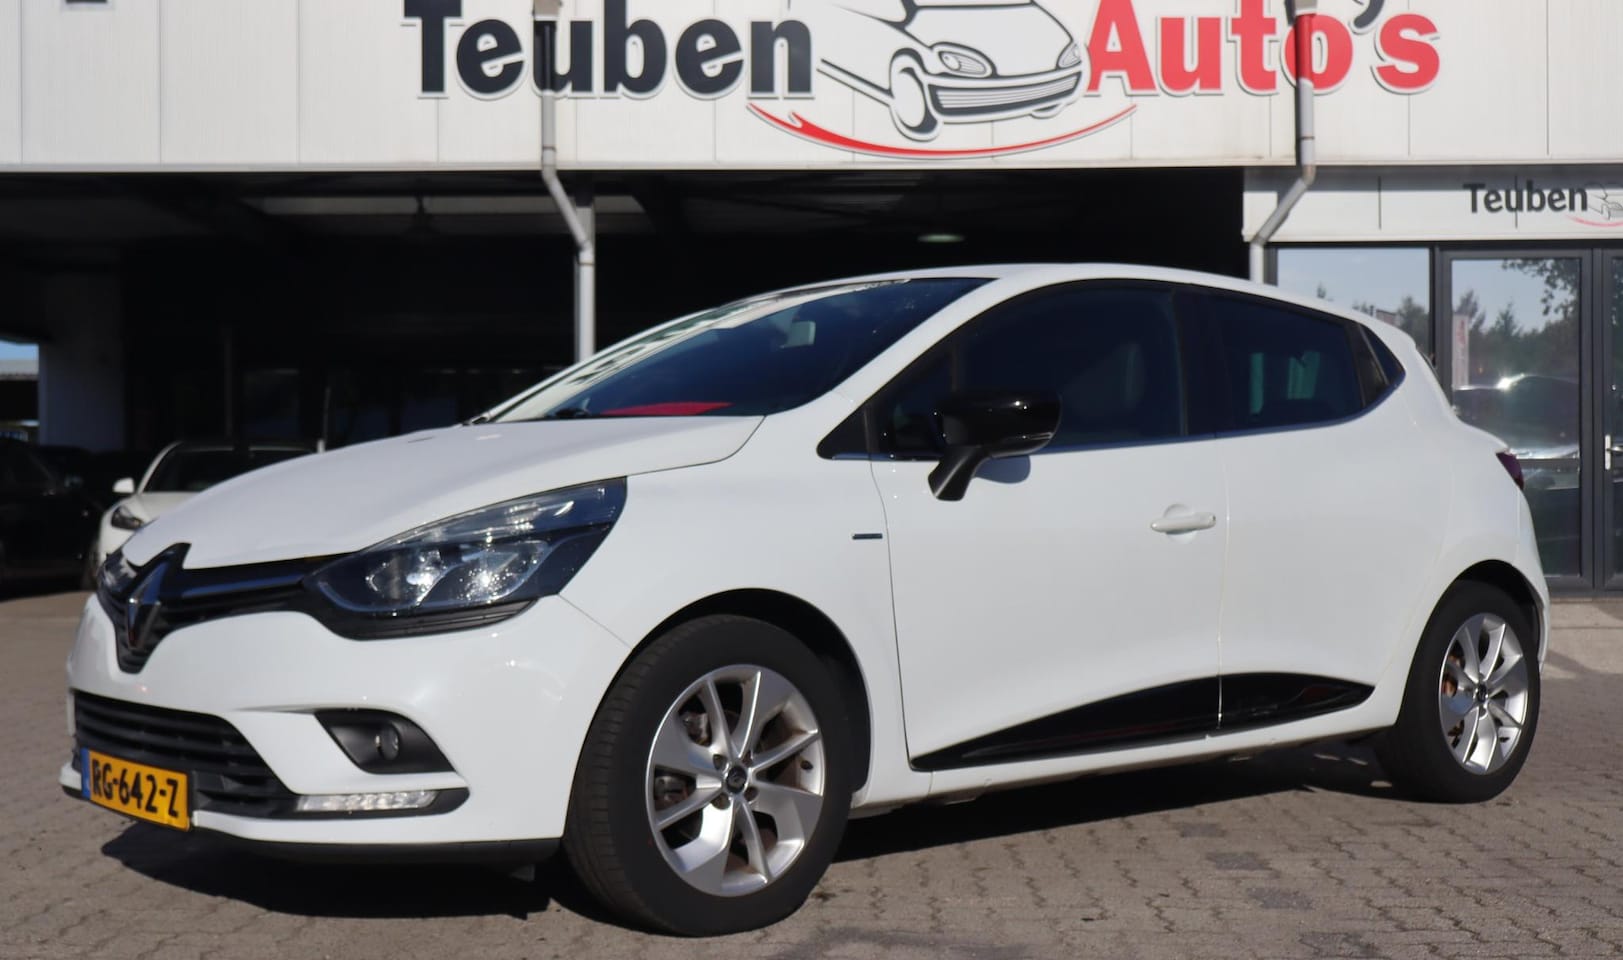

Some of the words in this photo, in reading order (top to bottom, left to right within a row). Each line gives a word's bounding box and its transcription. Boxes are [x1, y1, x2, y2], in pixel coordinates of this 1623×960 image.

[403, 0, 813, 94] Teuben
[1462, 179, 1588, 214] Teuben
[91, 758, 179, 818] RG-642-Z
